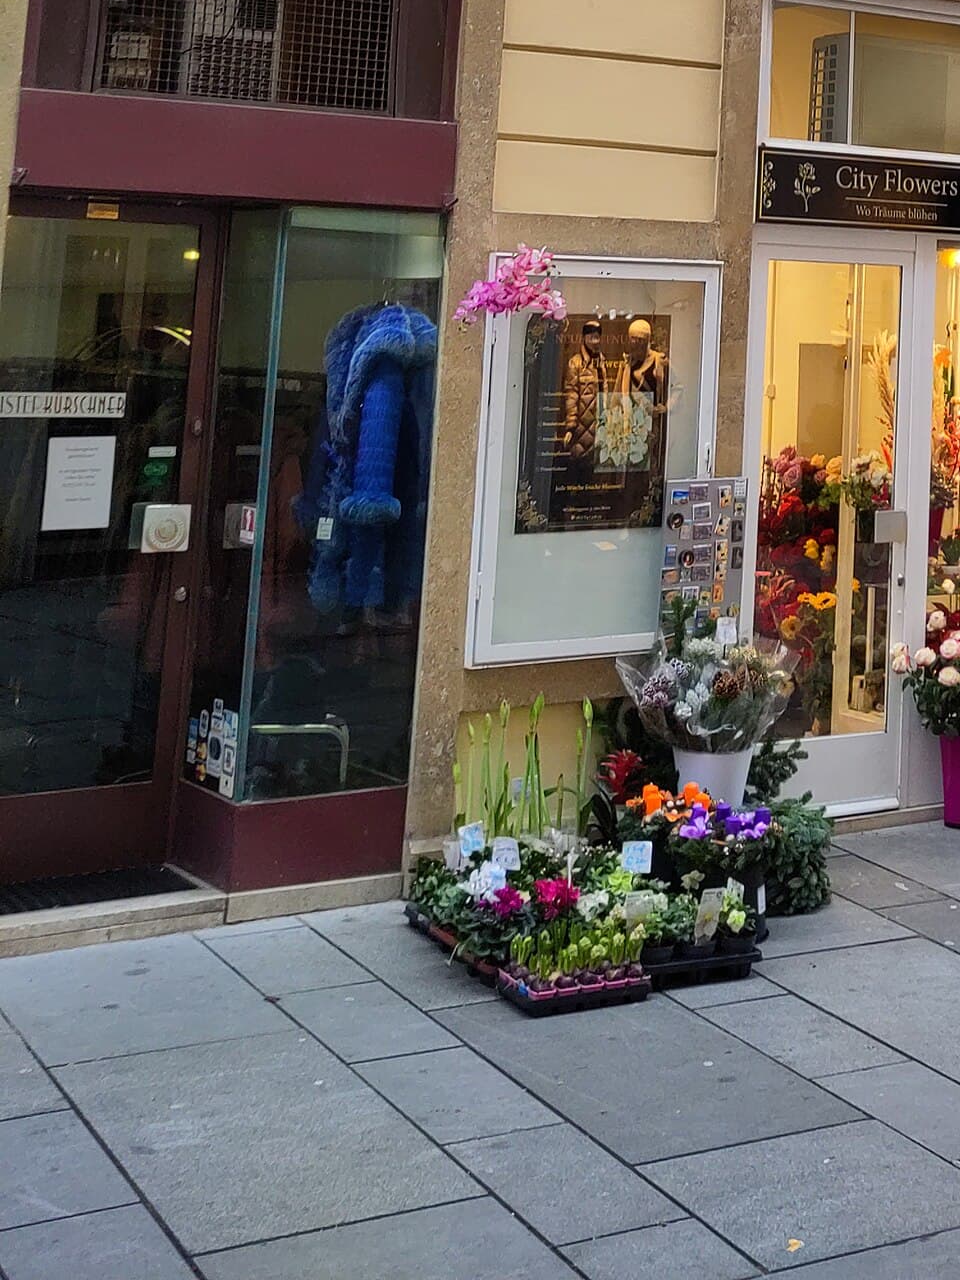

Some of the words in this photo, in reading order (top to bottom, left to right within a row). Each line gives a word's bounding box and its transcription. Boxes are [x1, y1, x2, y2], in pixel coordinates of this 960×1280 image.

[835, 165, 878, 198] City
[884, 169, 958, 198] Flowers
[855, 203, 871, 218] Wo
[873, 205, 906, 219] Träume
[908, 208, 938, 221] blühen
